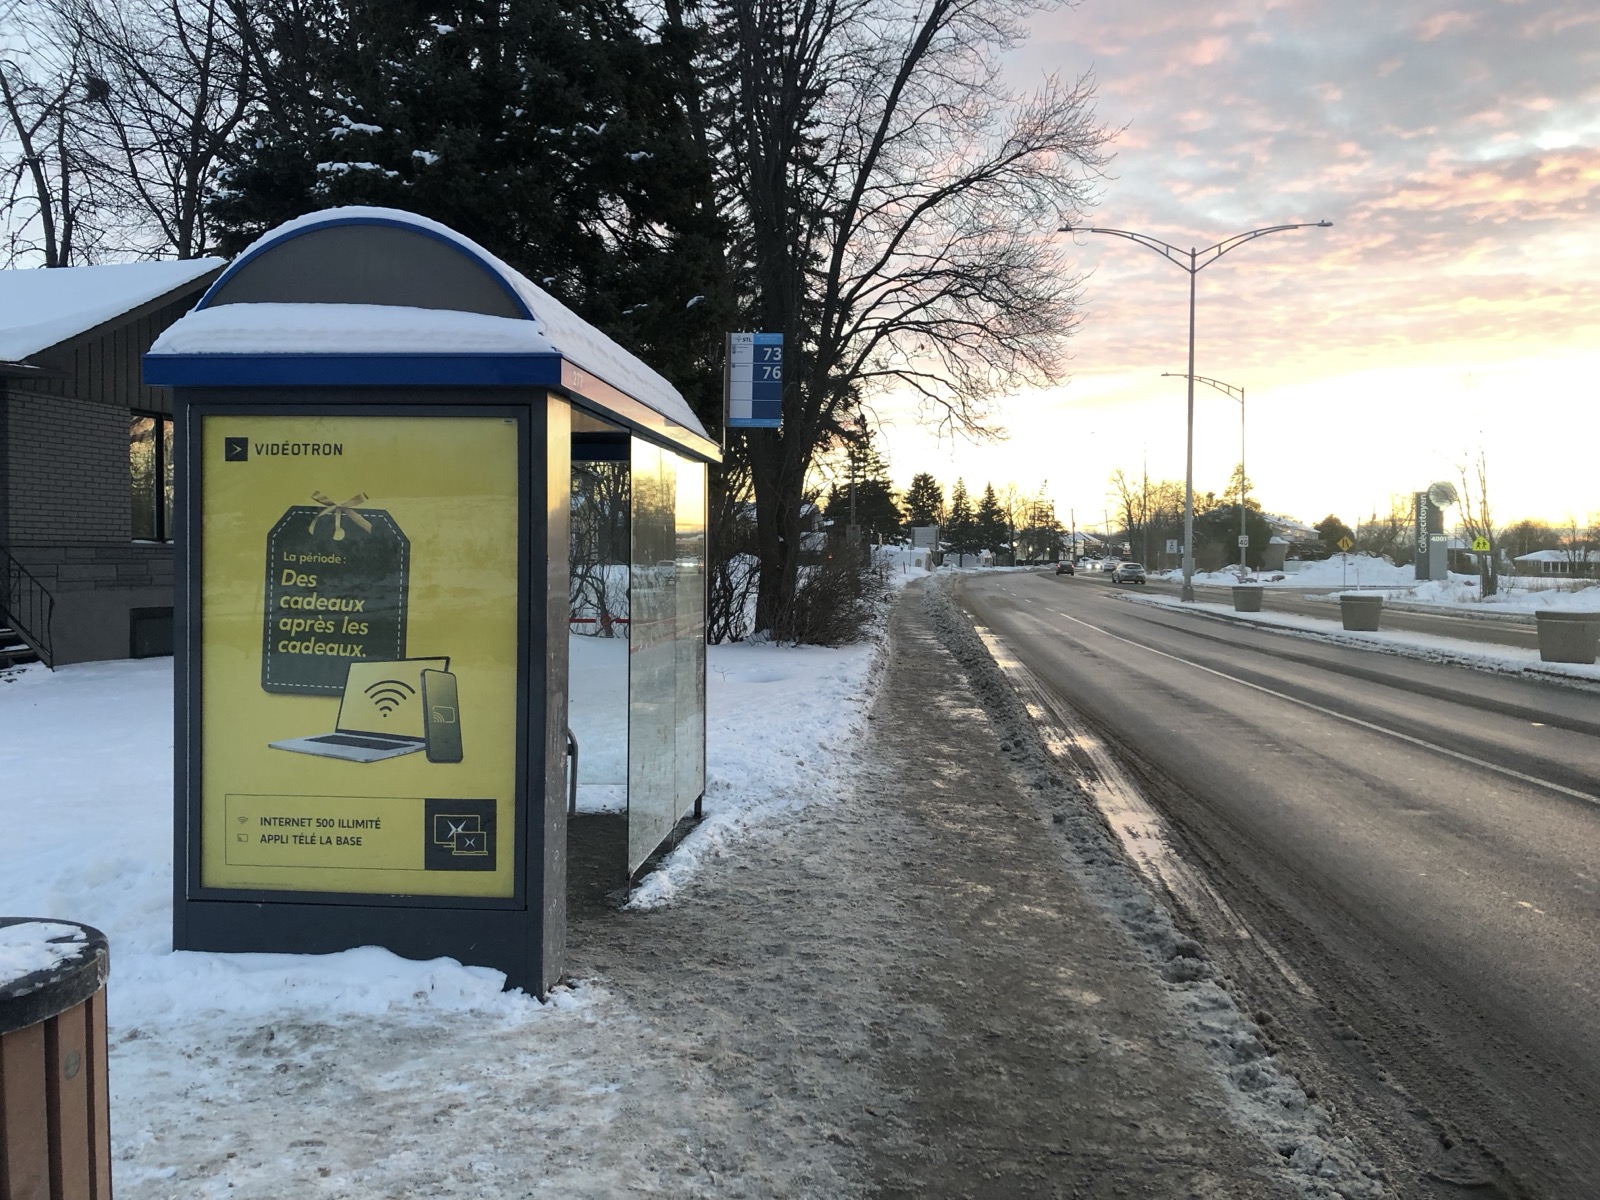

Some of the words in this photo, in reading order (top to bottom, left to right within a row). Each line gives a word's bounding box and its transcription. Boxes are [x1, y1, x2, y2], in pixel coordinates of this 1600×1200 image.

[763, 347, 782, 361] 73
[763, 366, 782, 379] 76
[255, 440, 343, 455] VIDÉOTRON
[283, 552, 296, 562] La
[281, 569, 317, 587] Des
[279, 593, 365, 612] cadeaux
[278, 615, 335, 635] après
[341, 617, 369, 635] les
[277, 638, 367, 658] cadeaux.
[260, 817, 312, 827] INTERNET
[316, 818, 335, 828] 500
[338, 817, 381, 829] ILLIMITÉ
[260, 834, 289, 845] APPLI
[292, 832, 317, 846] TÉLÉ
[319, 835, 332, 845] LA
[336, 836, 362, 846] BASE
